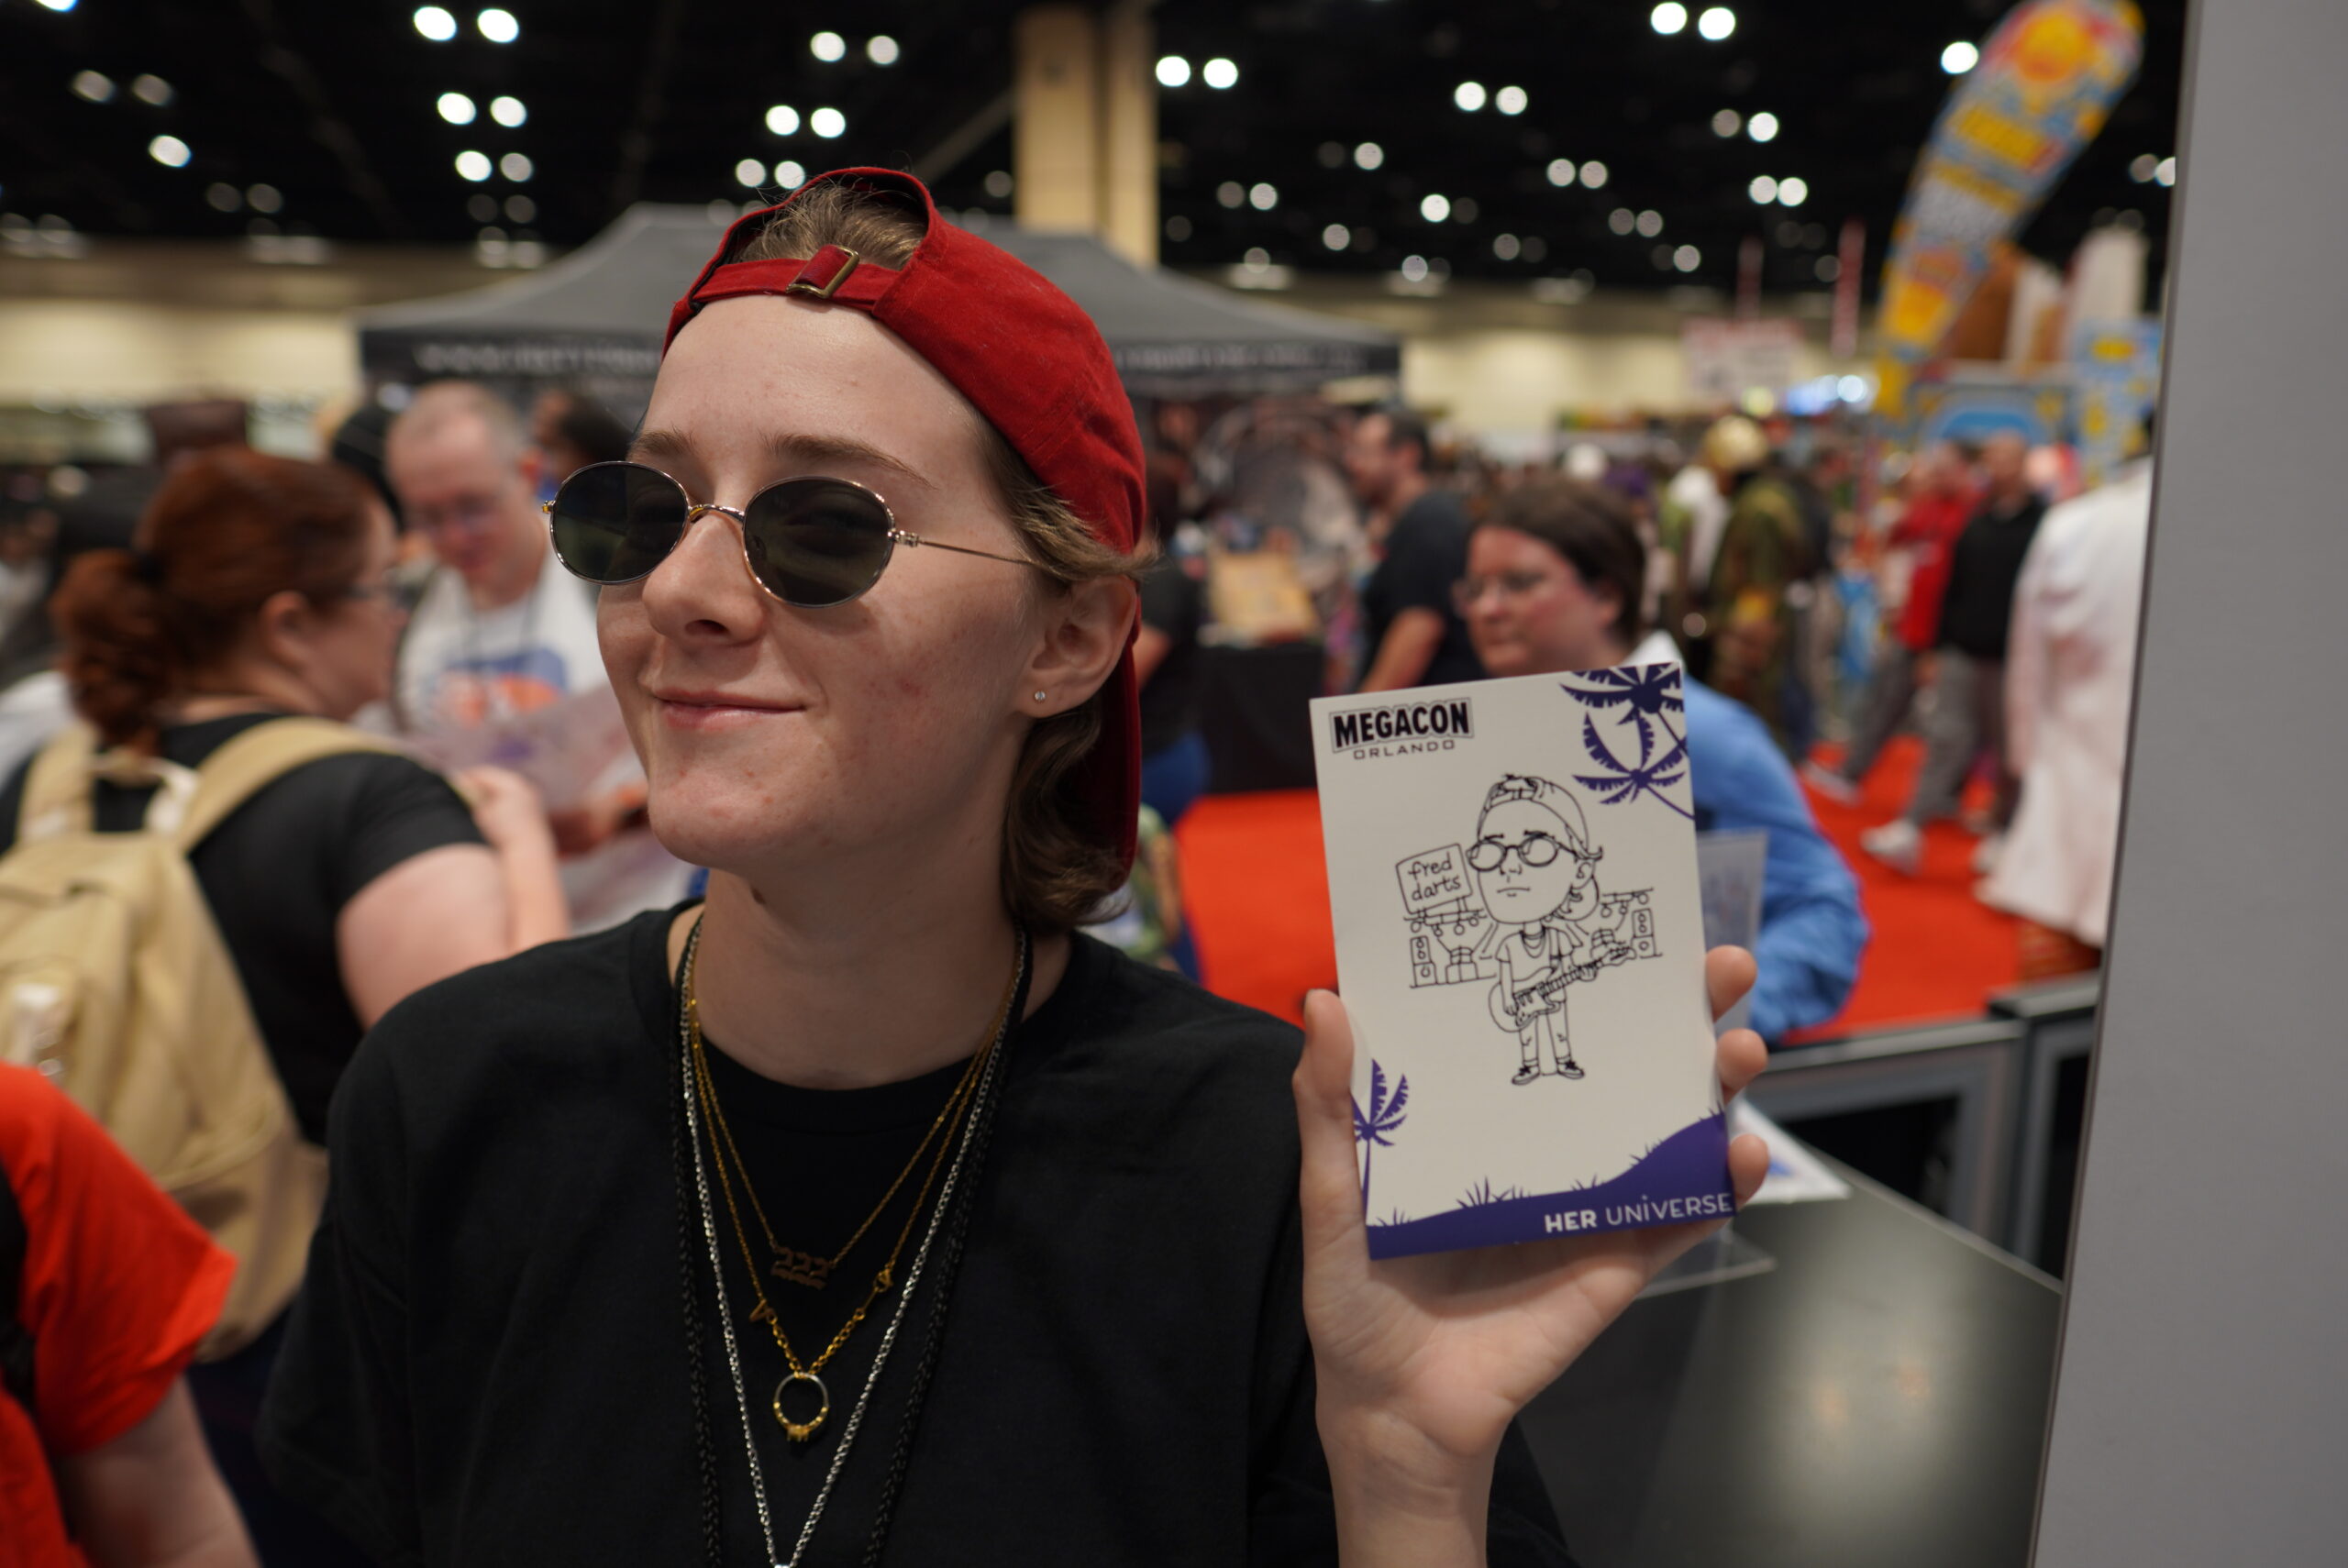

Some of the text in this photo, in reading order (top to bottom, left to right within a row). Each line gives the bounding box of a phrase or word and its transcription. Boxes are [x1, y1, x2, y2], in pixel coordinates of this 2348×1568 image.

[1334, 702, 1469, 748] MEGACON
[1353, 739, 1456, 761] ORLANDO
[1408, 852, 1453, 879] fred
[1412, 875, 1462, 902] darts
[1545, 1209, 1598, 1234] HER
